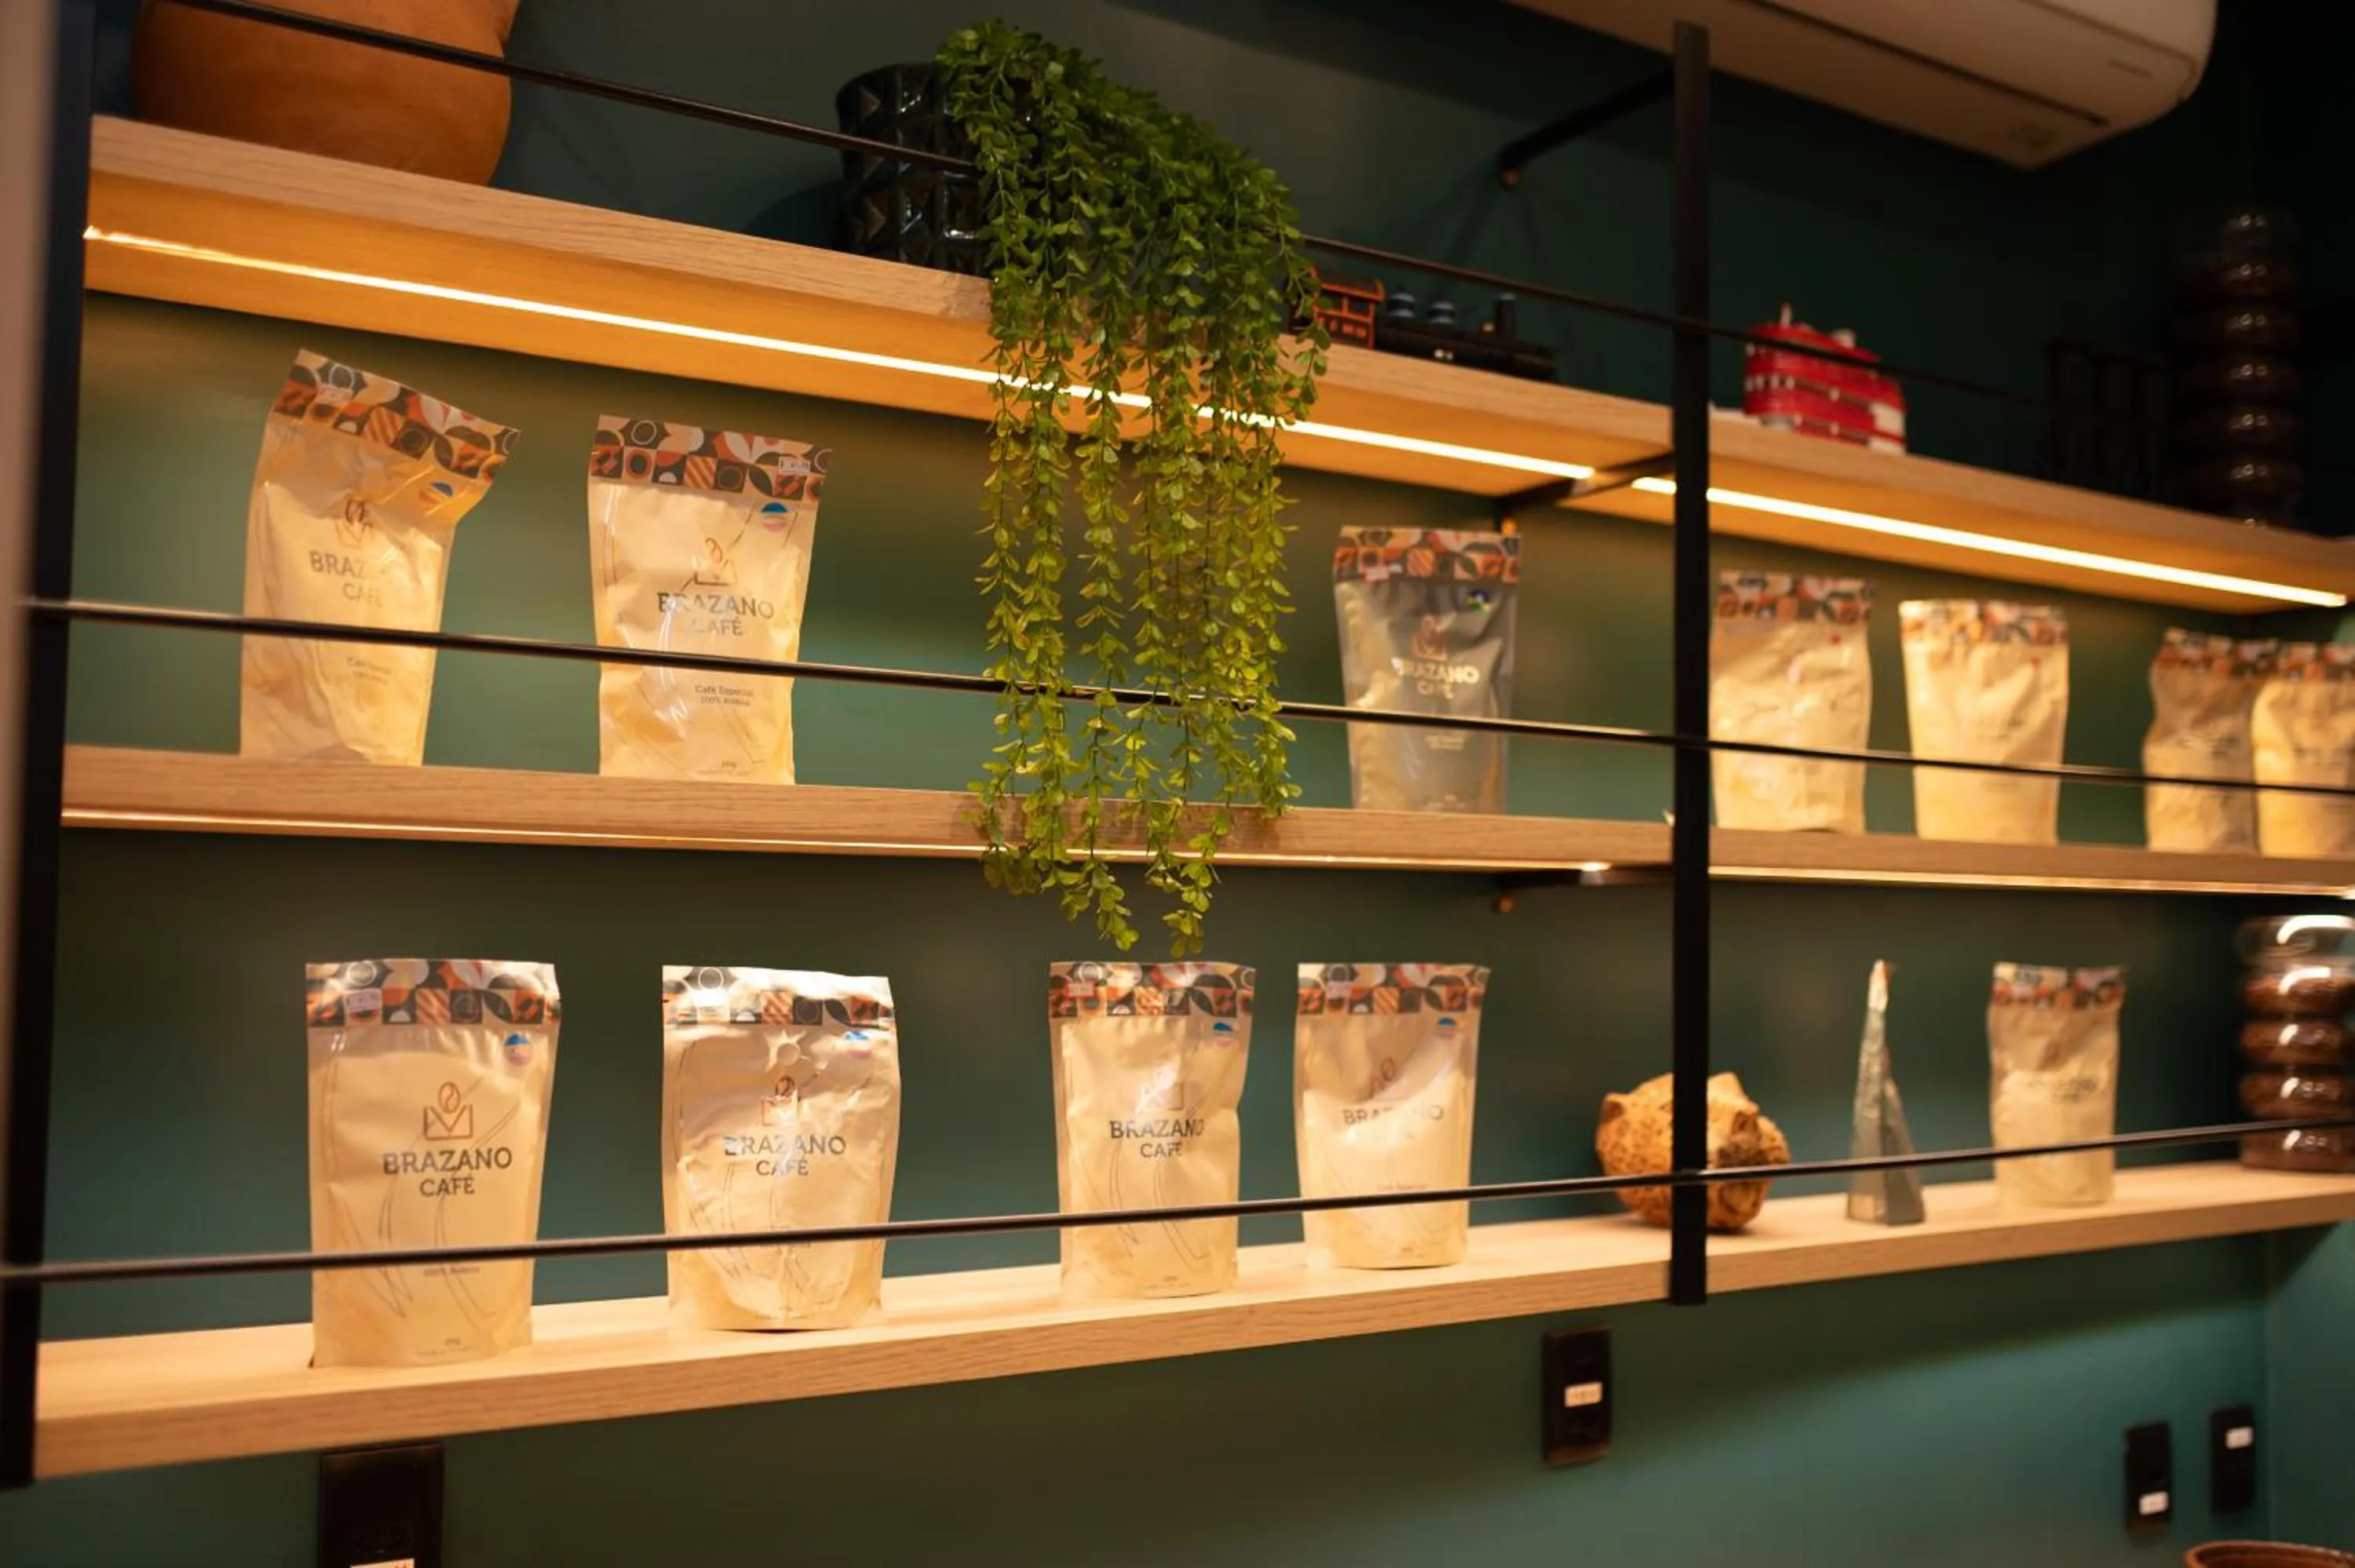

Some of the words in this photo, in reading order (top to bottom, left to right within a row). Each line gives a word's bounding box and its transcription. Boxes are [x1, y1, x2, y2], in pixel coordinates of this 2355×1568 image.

[1391, 658, 1480, 684] AZANO
[1109, 1118, 1204, 1139] BRAZANO
[382, 1146, 512, 1175] BRAZANO
